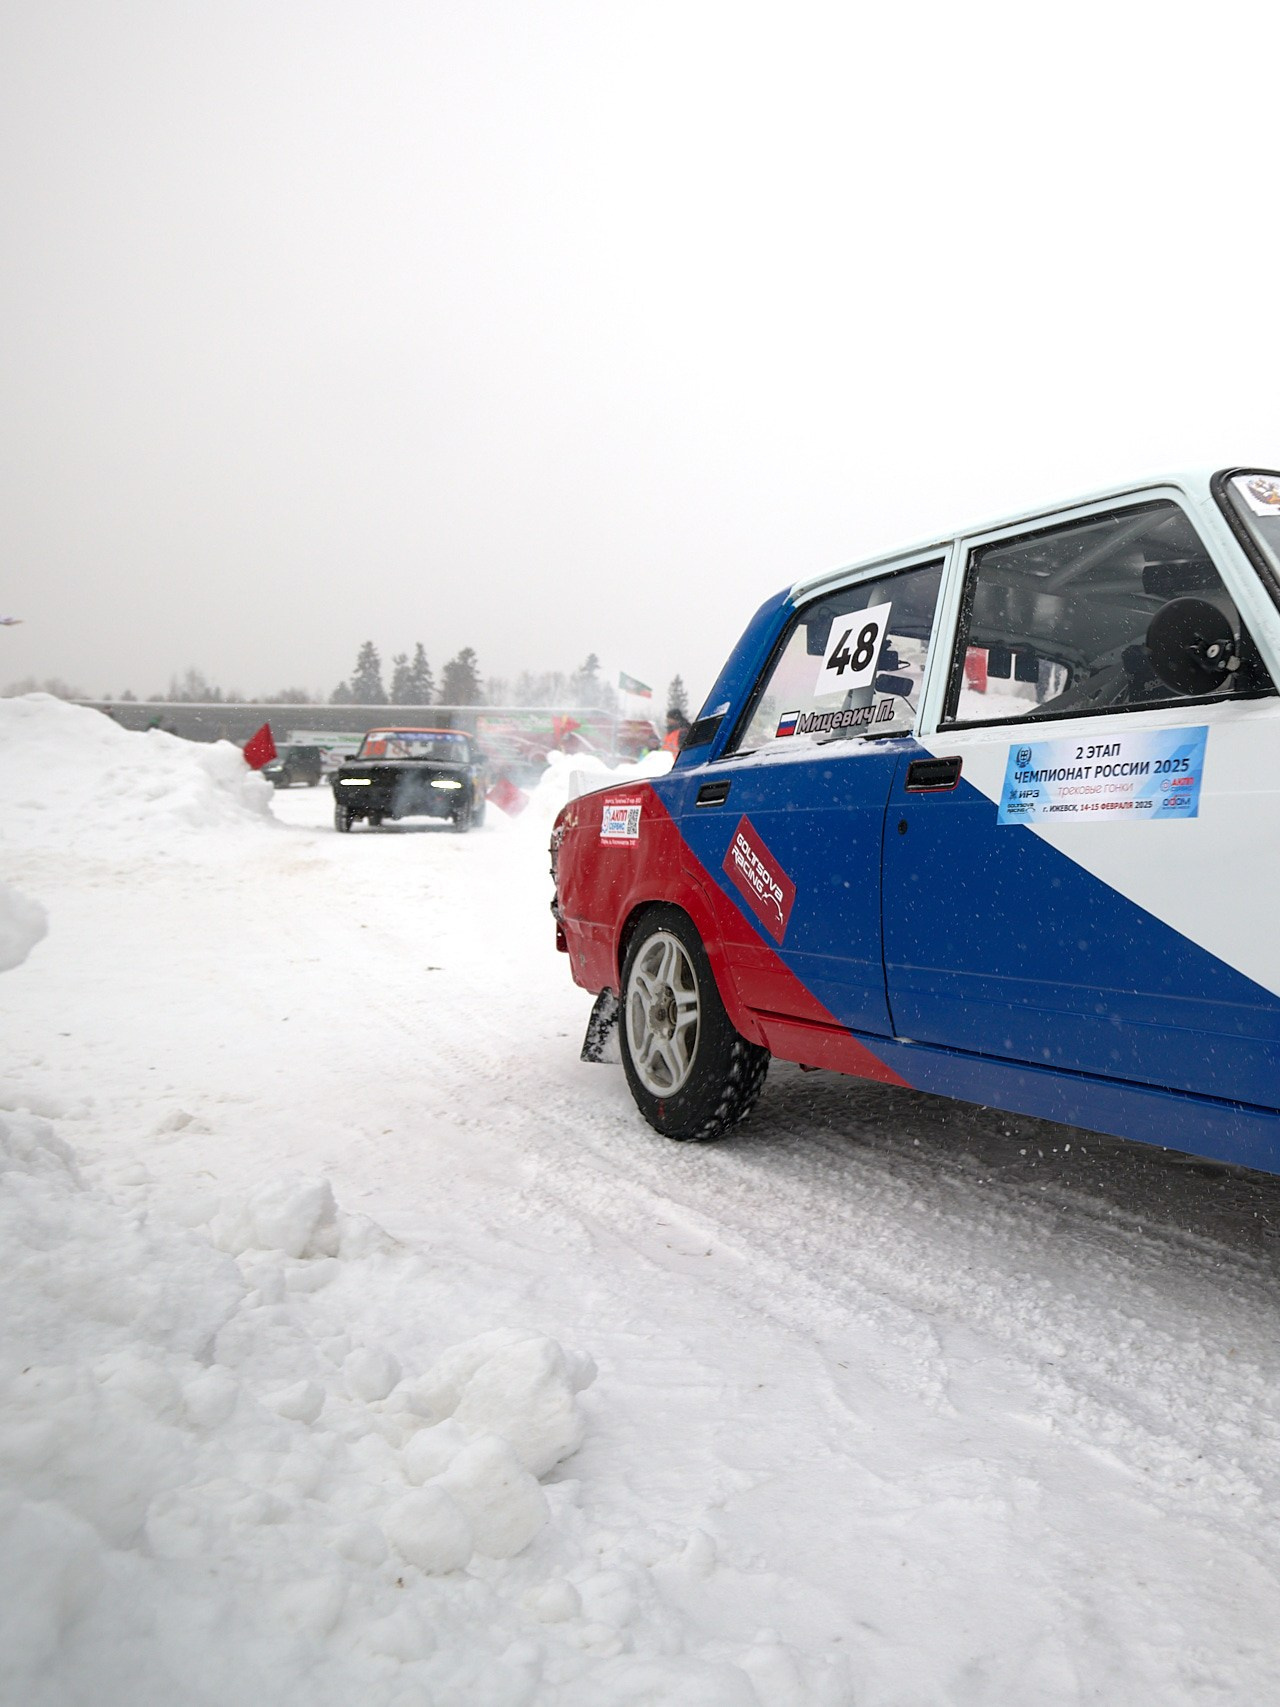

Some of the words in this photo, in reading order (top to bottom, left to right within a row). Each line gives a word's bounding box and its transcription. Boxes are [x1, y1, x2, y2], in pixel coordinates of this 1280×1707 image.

[826, 623, 879, 675] 48
[796, 705, 876, 734] Мицевич
[876, 698, 895, 723] П.
[1075, 746, 1084, 760] 2
[1086, 743, 1121, 759] ЭТАП
[1014, 766, 1092, 784] ЧЕМПИОНАТ
[1094, 761, 1150, 779] РОССИИ
[1153, 758, 1190, 774] 2025
[1080, 803, 1099, 812] 14-15
[1100, 802, 1133, 811] ФЕВРАЛЯ
